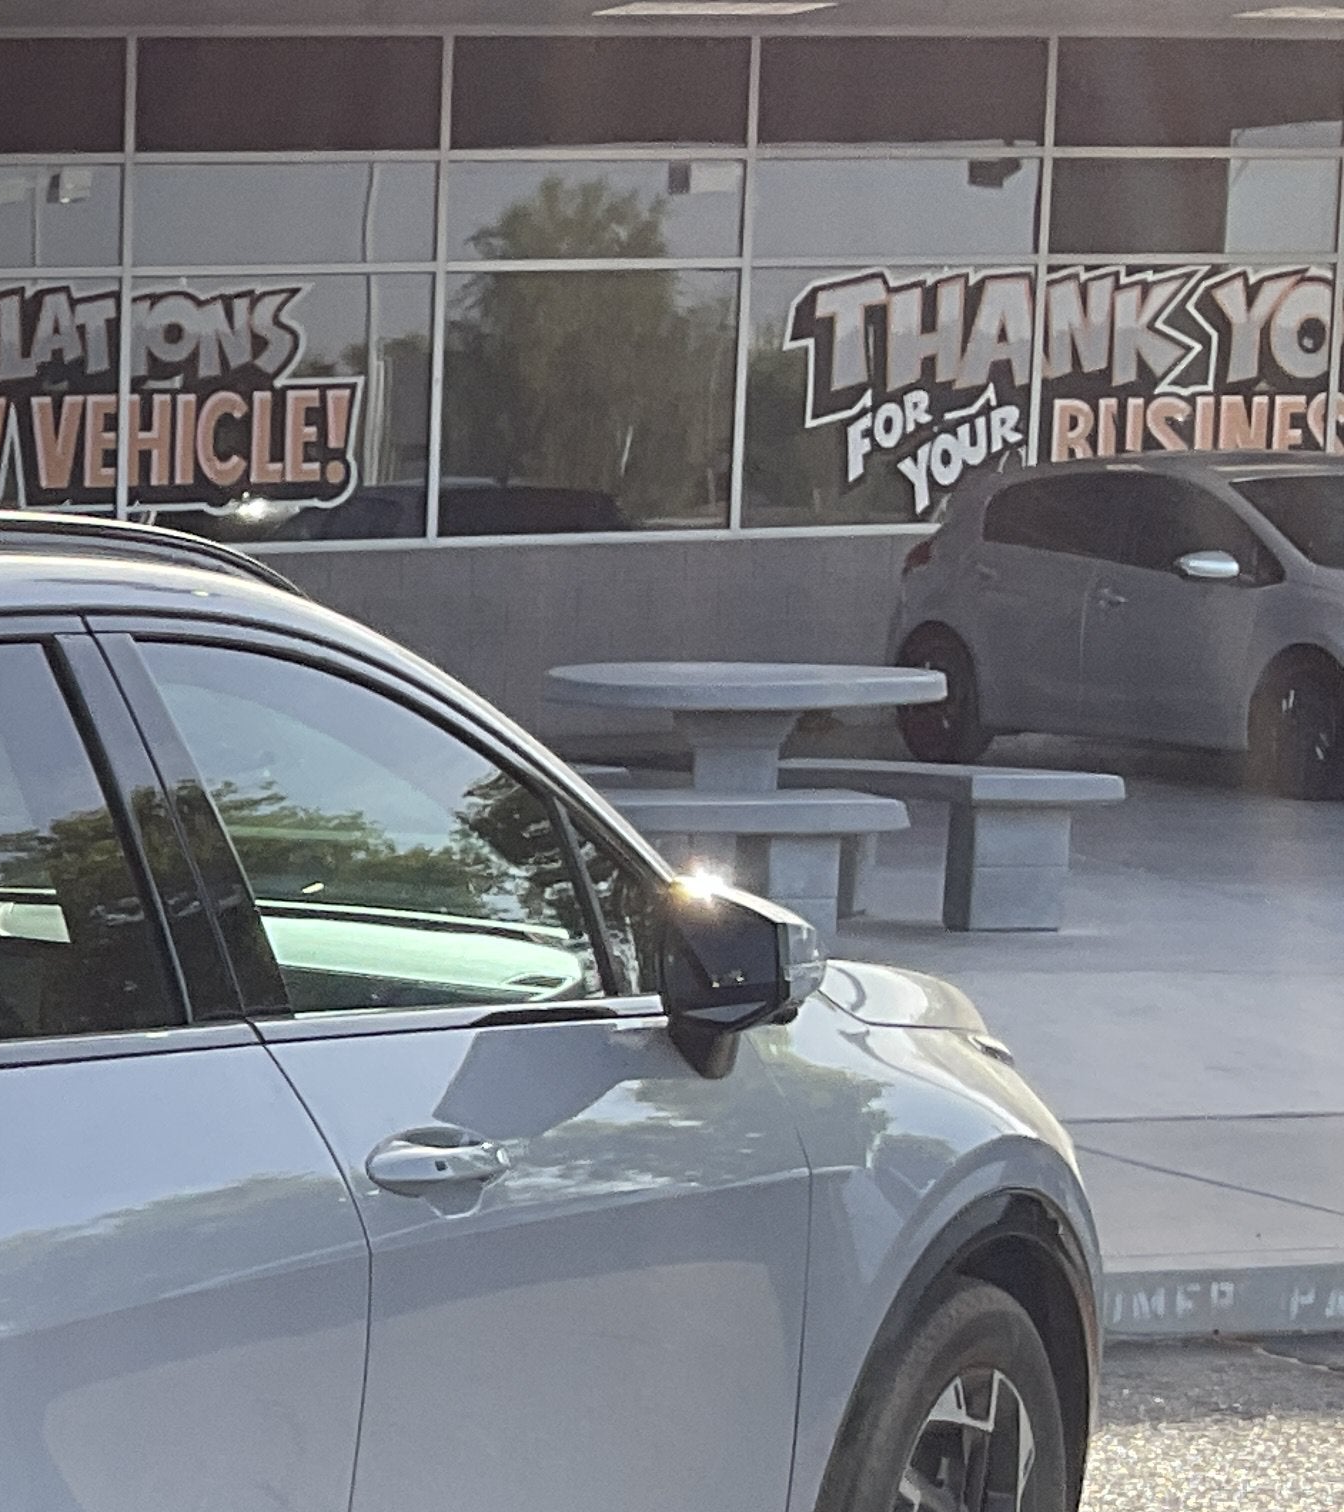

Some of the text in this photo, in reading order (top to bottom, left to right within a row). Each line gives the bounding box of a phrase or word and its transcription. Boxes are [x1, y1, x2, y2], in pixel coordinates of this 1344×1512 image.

[815, 270, 1344, 394] THANK YO
[30, 387, 353, 489] VEHICLE!
[846, 388, 933, 483] FOR
[896, 404, 1024, 515] YOUR
